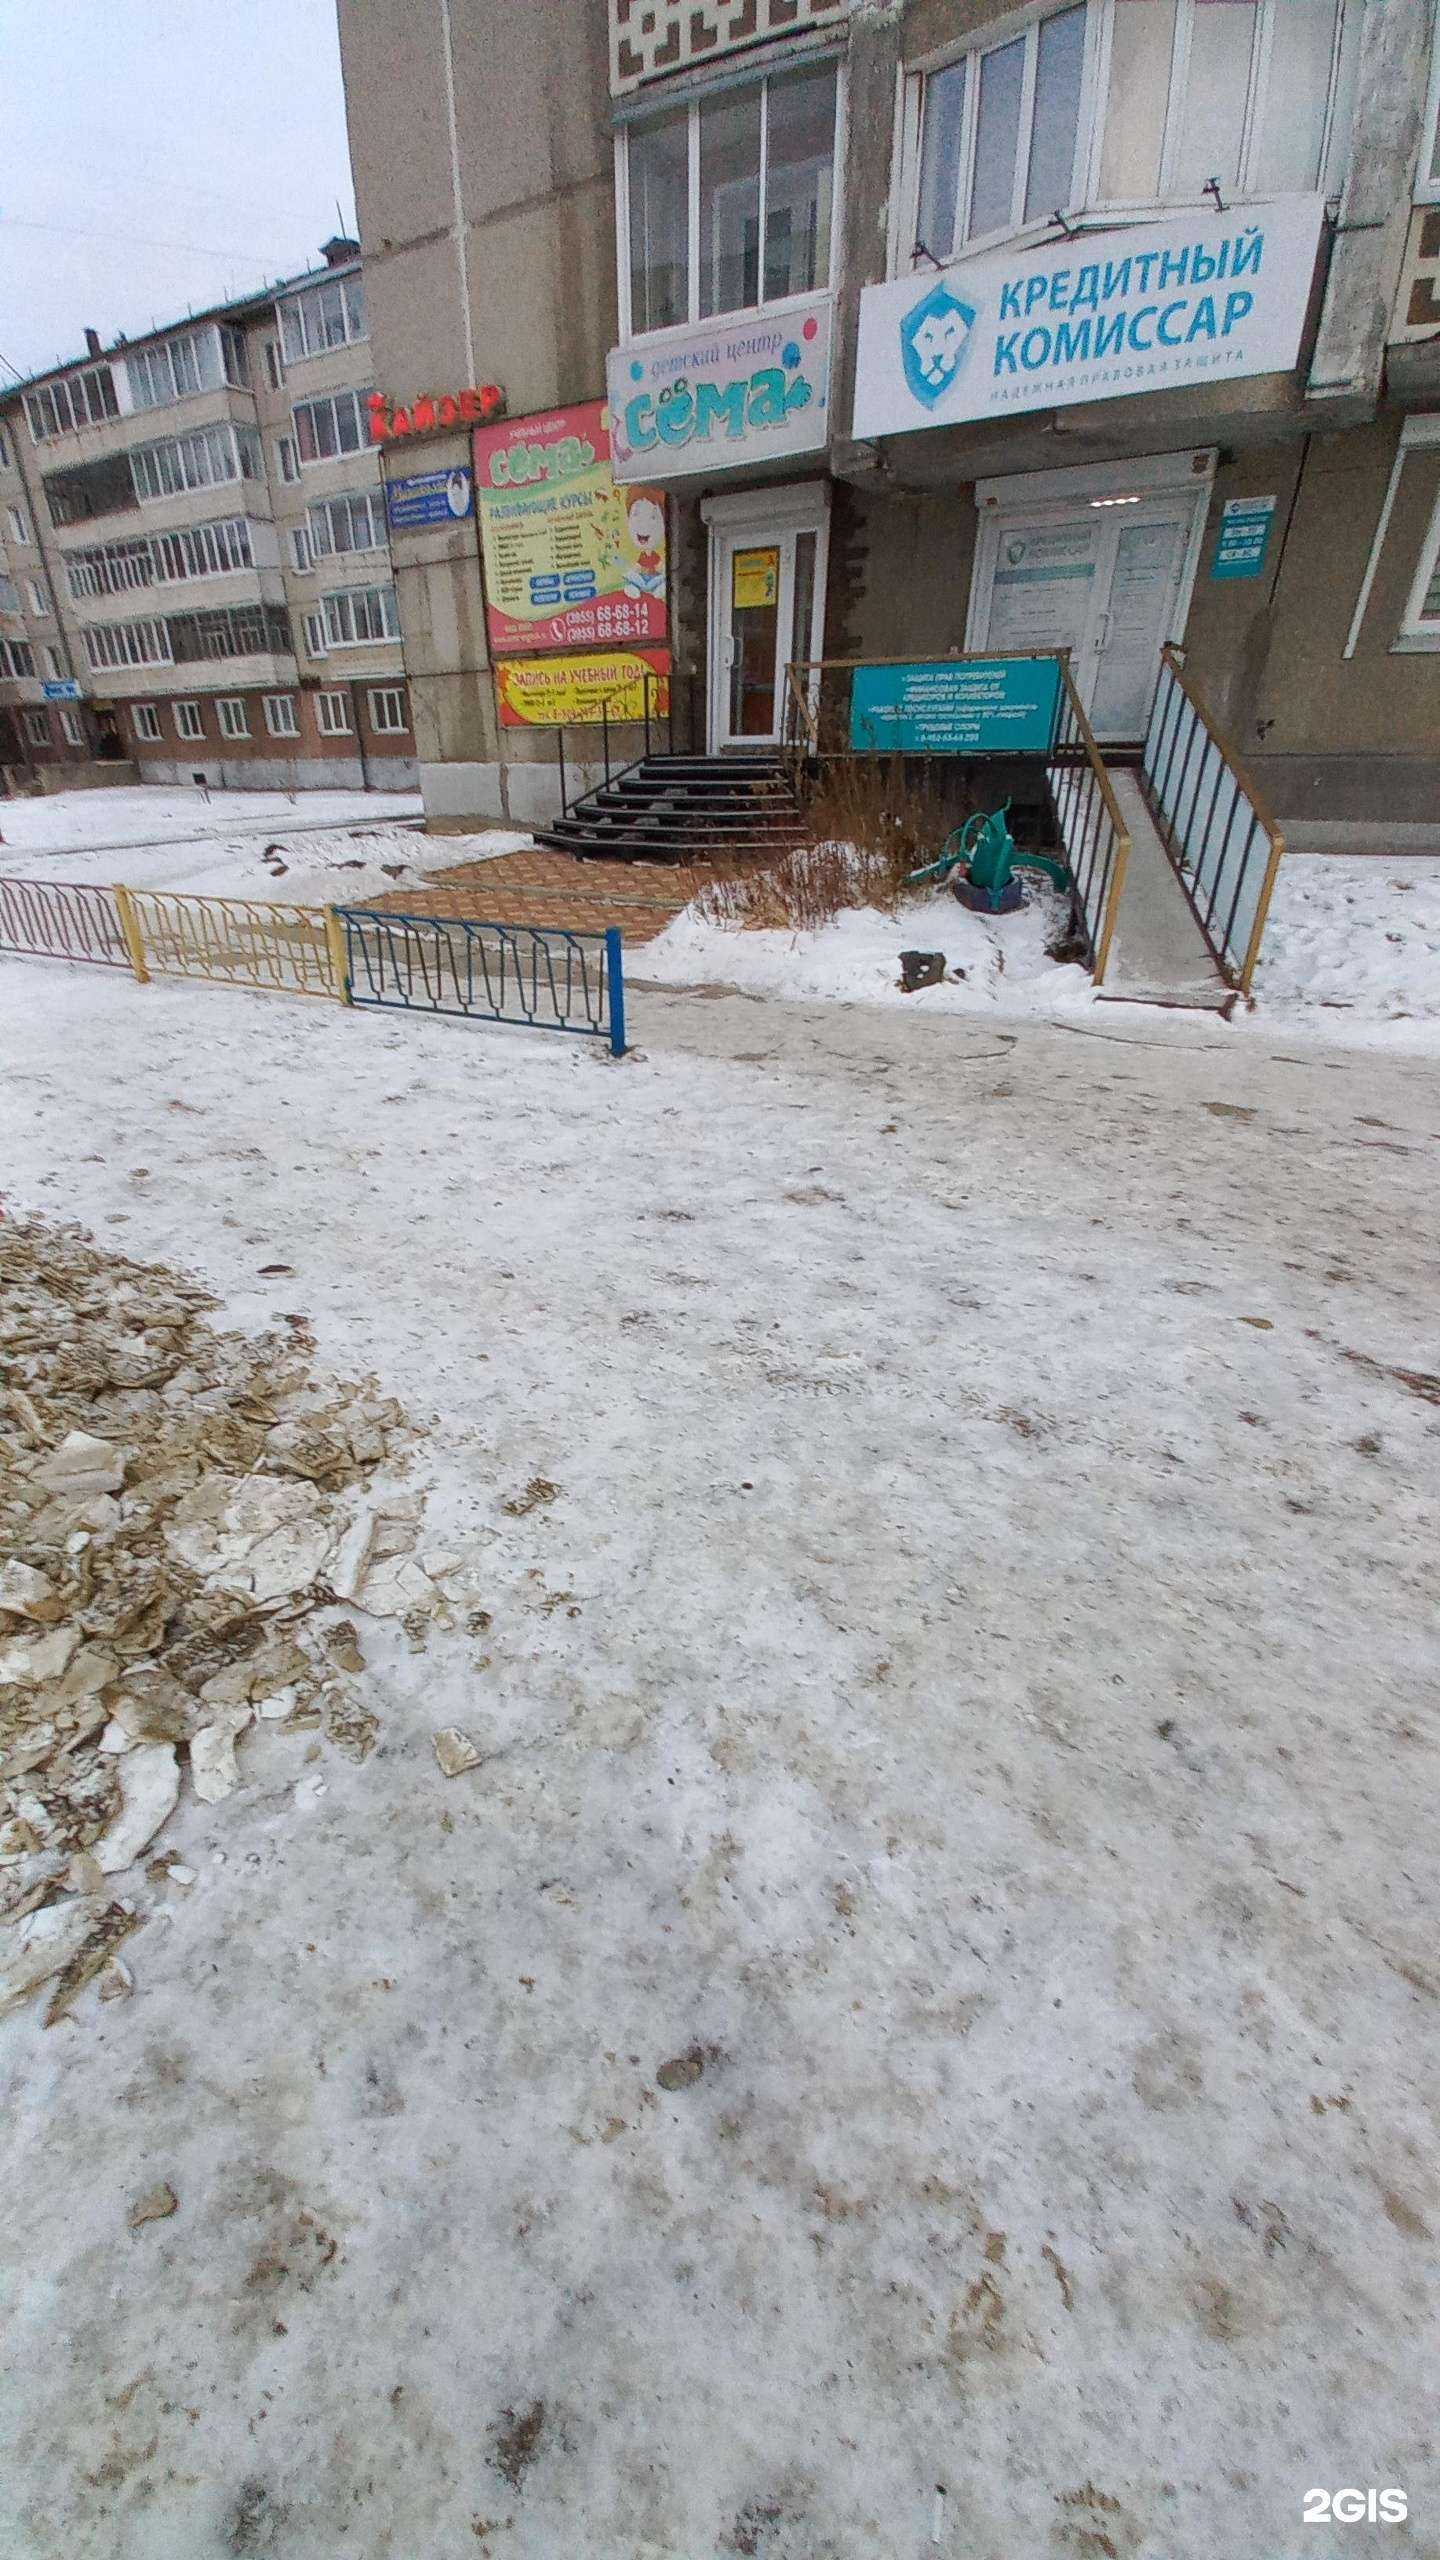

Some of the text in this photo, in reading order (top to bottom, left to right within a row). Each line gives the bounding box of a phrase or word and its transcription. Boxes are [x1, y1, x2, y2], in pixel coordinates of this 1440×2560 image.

[1000, 225, 1265, 320] КРЕДИТНЫЙ
[726, 333, 784, 361] центр
[993, 290, 1255, 377] КОМИССАР
[1174, 349, 1245, 376] ЗАЩИТА
[596, 602, 649, 621] 68-68-14
[597, 618, 649, 638] 68-68-12
[553, 671, 567, 686] НА
[570, 665, 617, 685] УЧЕБНЫЙ
